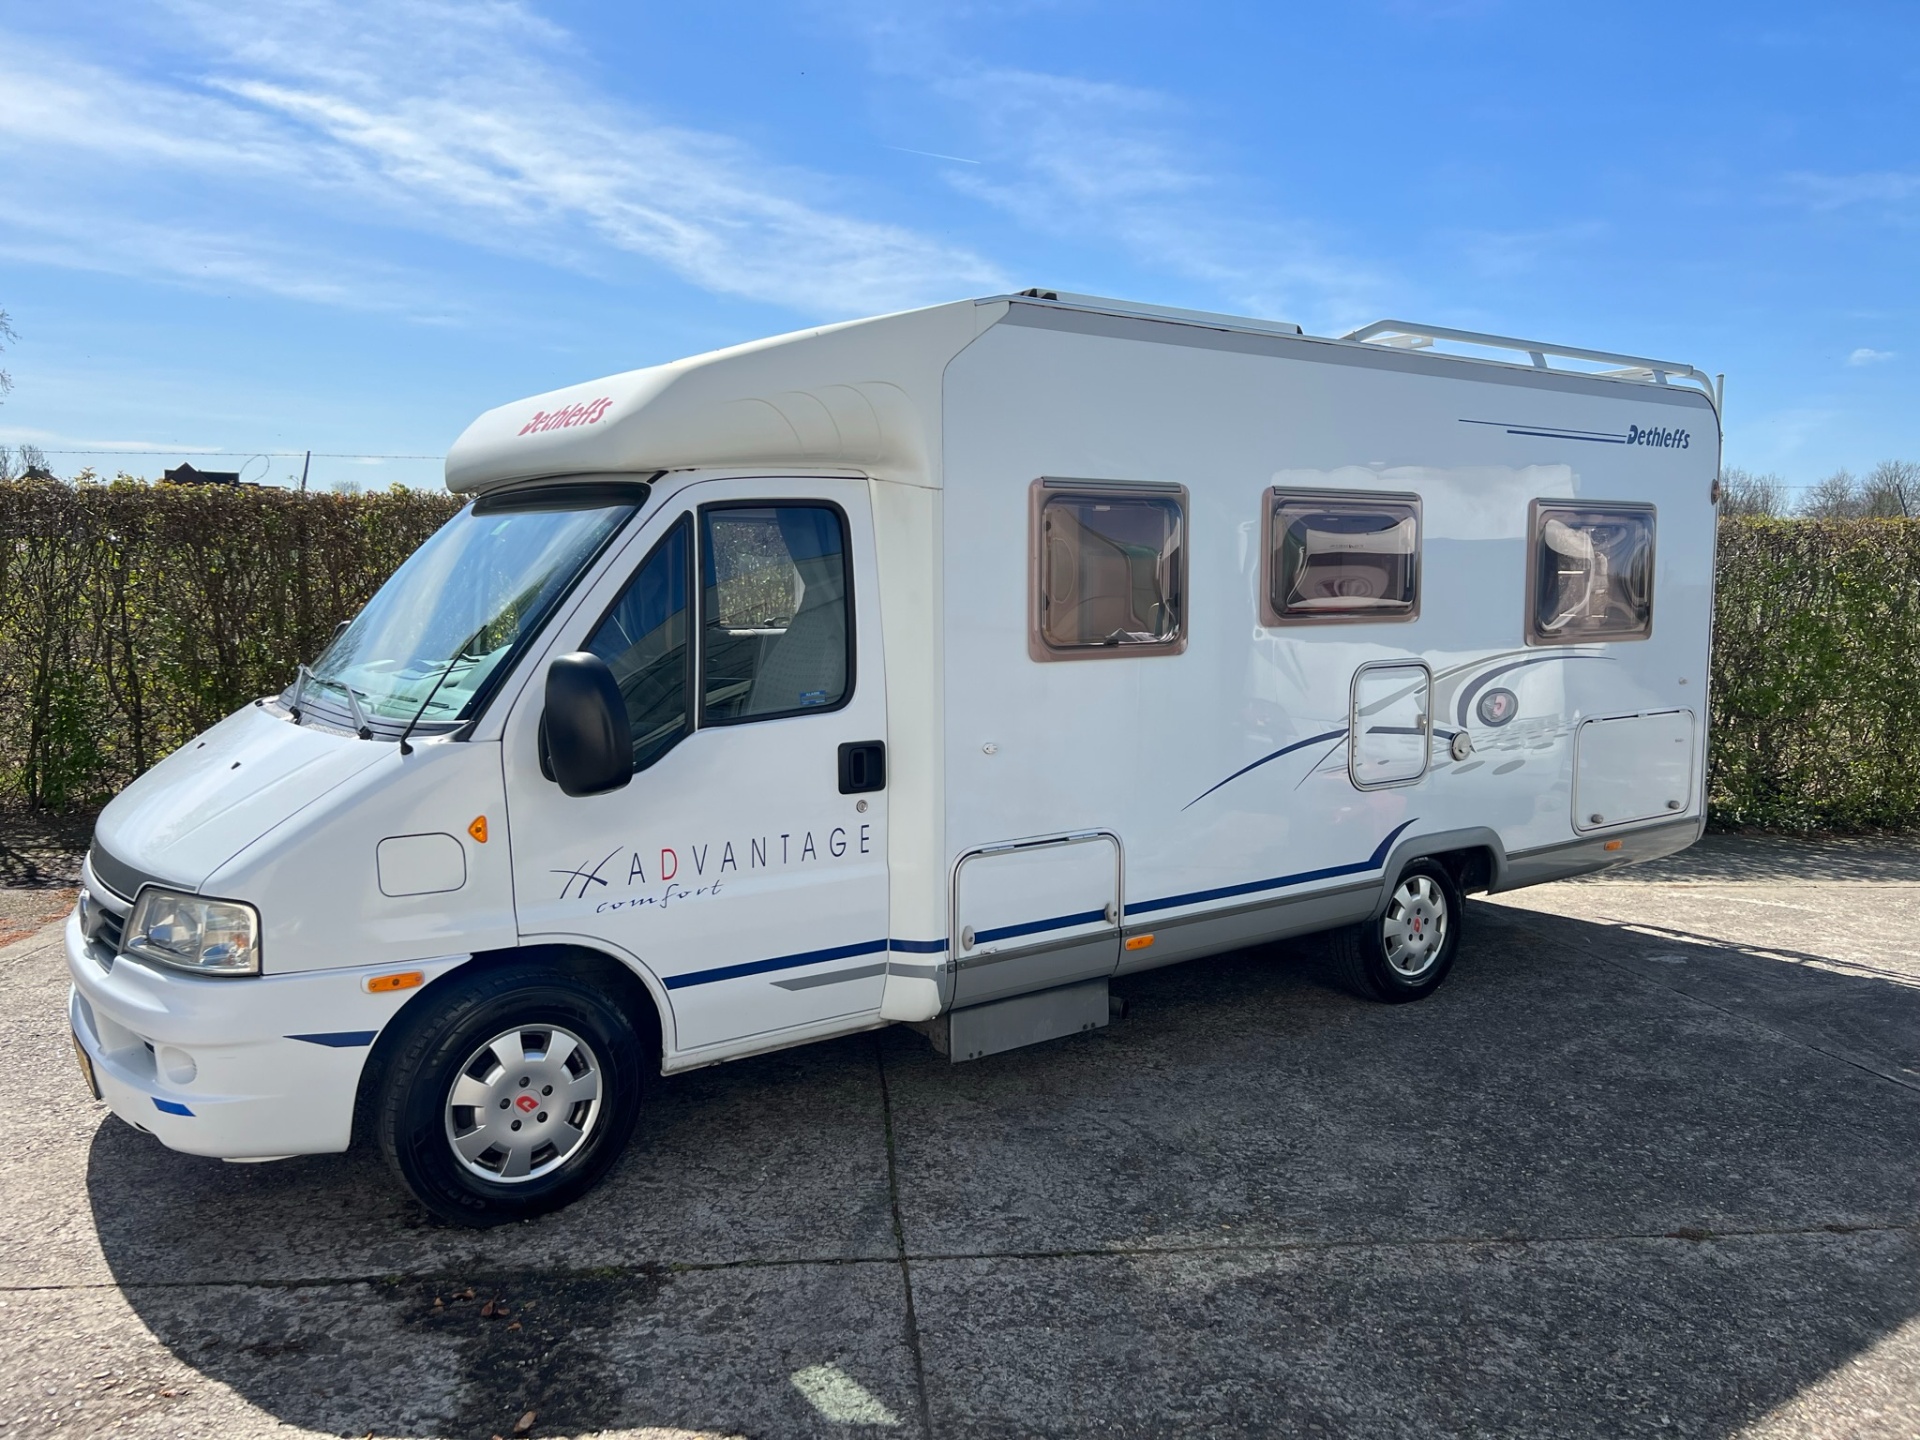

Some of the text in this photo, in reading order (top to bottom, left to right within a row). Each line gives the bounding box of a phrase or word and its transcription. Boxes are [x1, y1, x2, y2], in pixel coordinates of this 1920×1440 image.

[517, 397, 613, 436] Dethleffs
[1626, 424, 1691, 450] Dethleffs
[627, 824, 870, 886] ADVANTAGE
[596, 879, 724, 914] comfort
